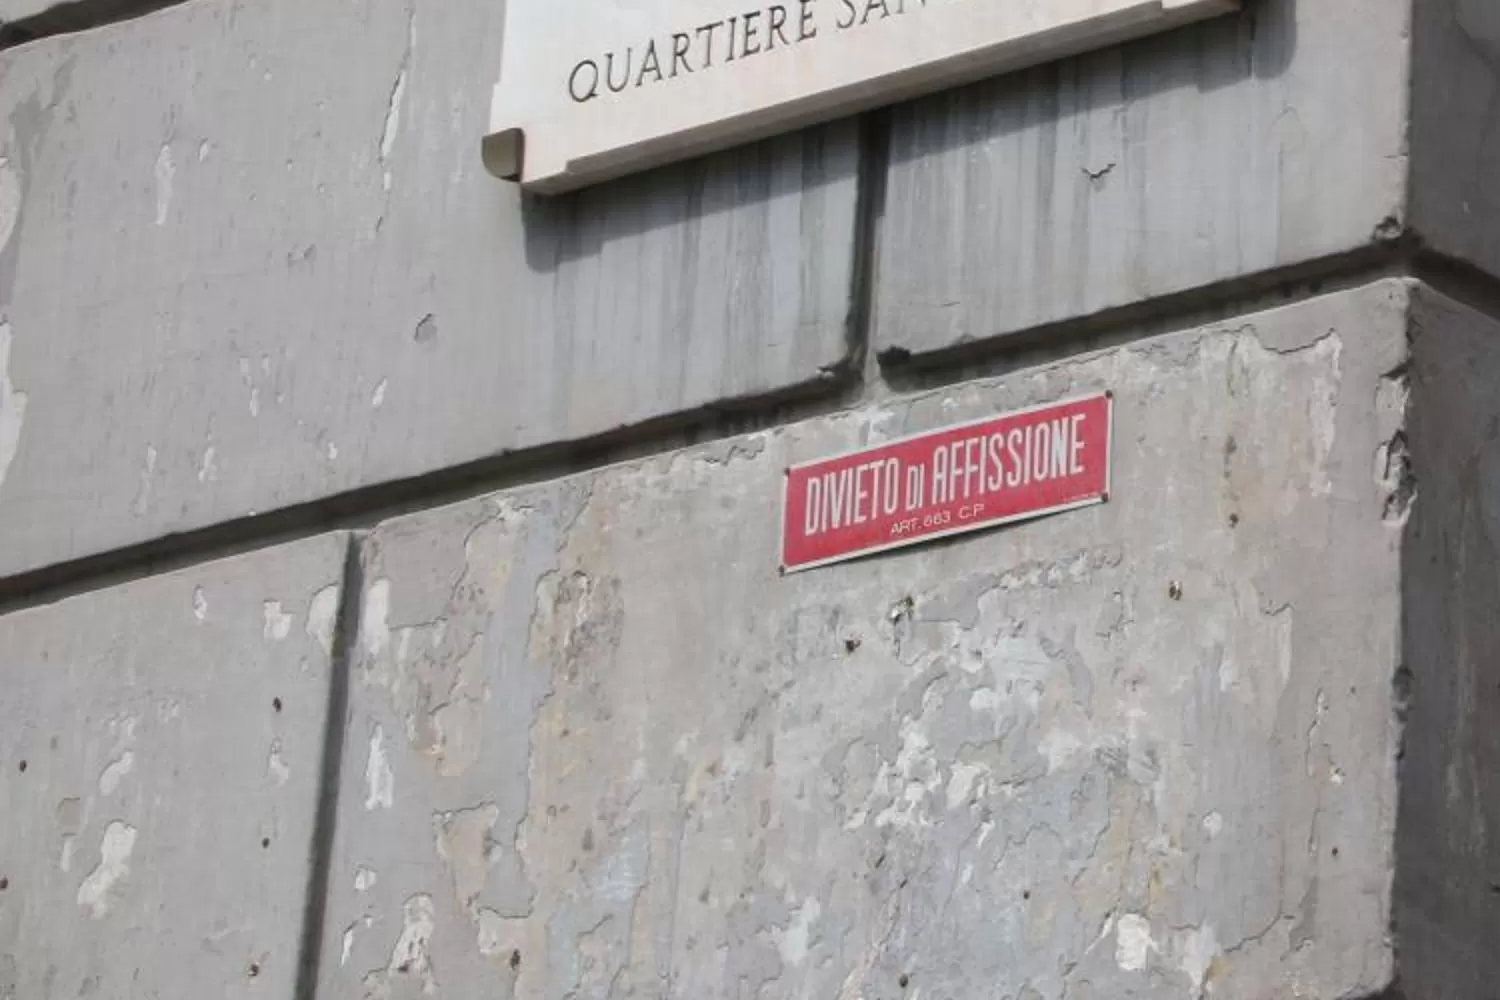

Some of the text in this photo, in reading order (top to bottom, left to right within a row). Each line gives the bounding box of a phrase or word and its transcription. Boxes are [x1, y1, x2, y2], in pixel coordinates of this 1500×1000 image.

[804, 413, 1086, 537] DIVIETO DI AFFISSIONE
